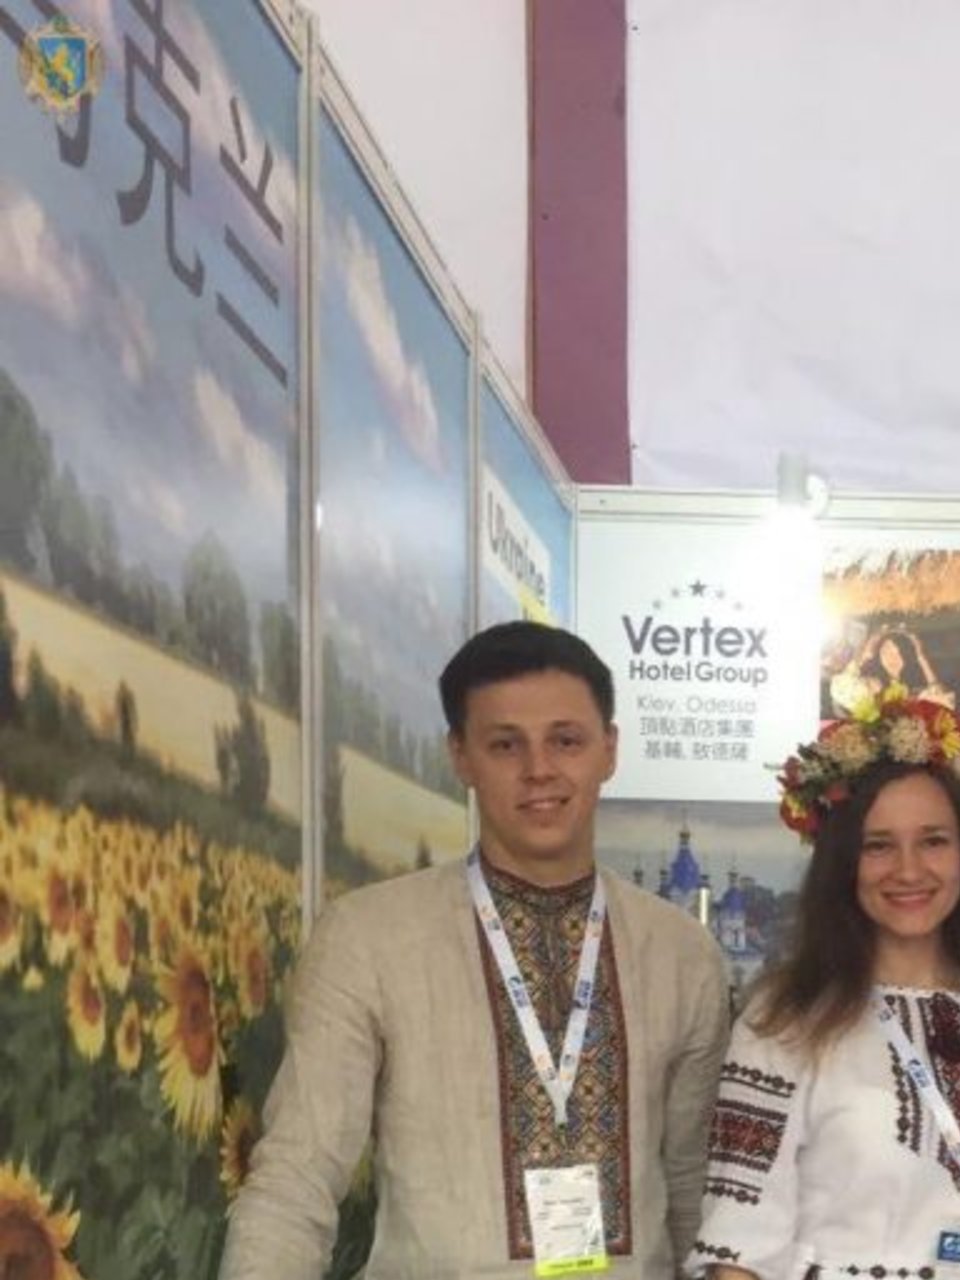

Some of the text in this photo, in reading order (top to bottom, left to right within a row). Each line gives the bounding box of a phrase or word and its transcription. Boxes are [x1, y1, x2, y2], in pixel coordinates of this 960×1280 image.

[621, 614, 768, 658] Vertex
[628, 659, 768, 687] Hotel Group
